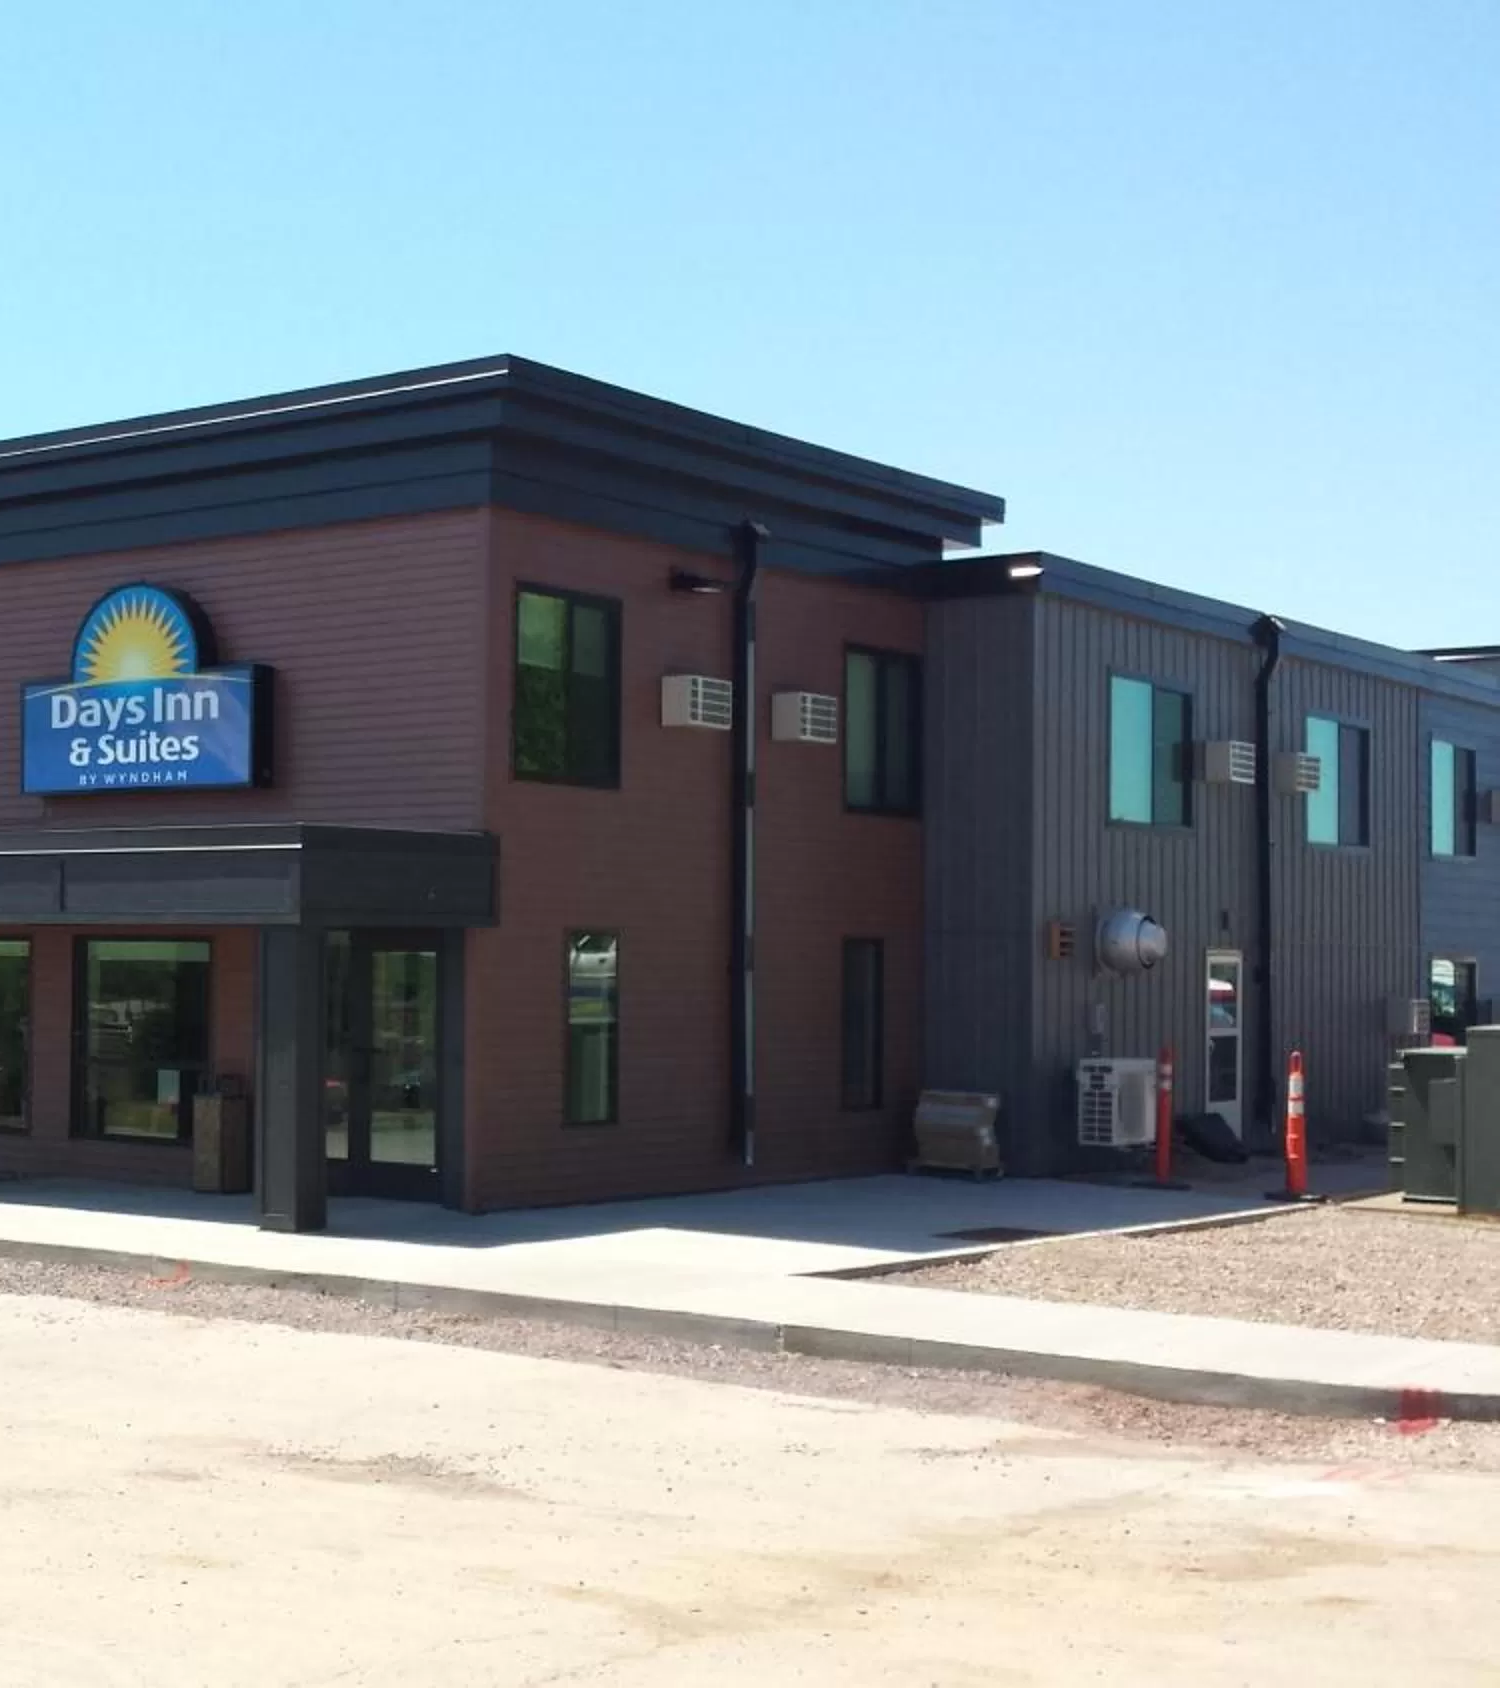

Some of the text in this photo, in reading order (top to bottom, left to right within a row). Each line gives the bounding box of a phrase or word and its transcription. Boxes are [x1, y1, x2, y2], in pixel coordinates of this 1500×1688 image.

[51, 687, 219, 731] Days Inn
[69, 729, 200, 766] & Suites
[79, 770, 188, 785] BY WYNDHAM
